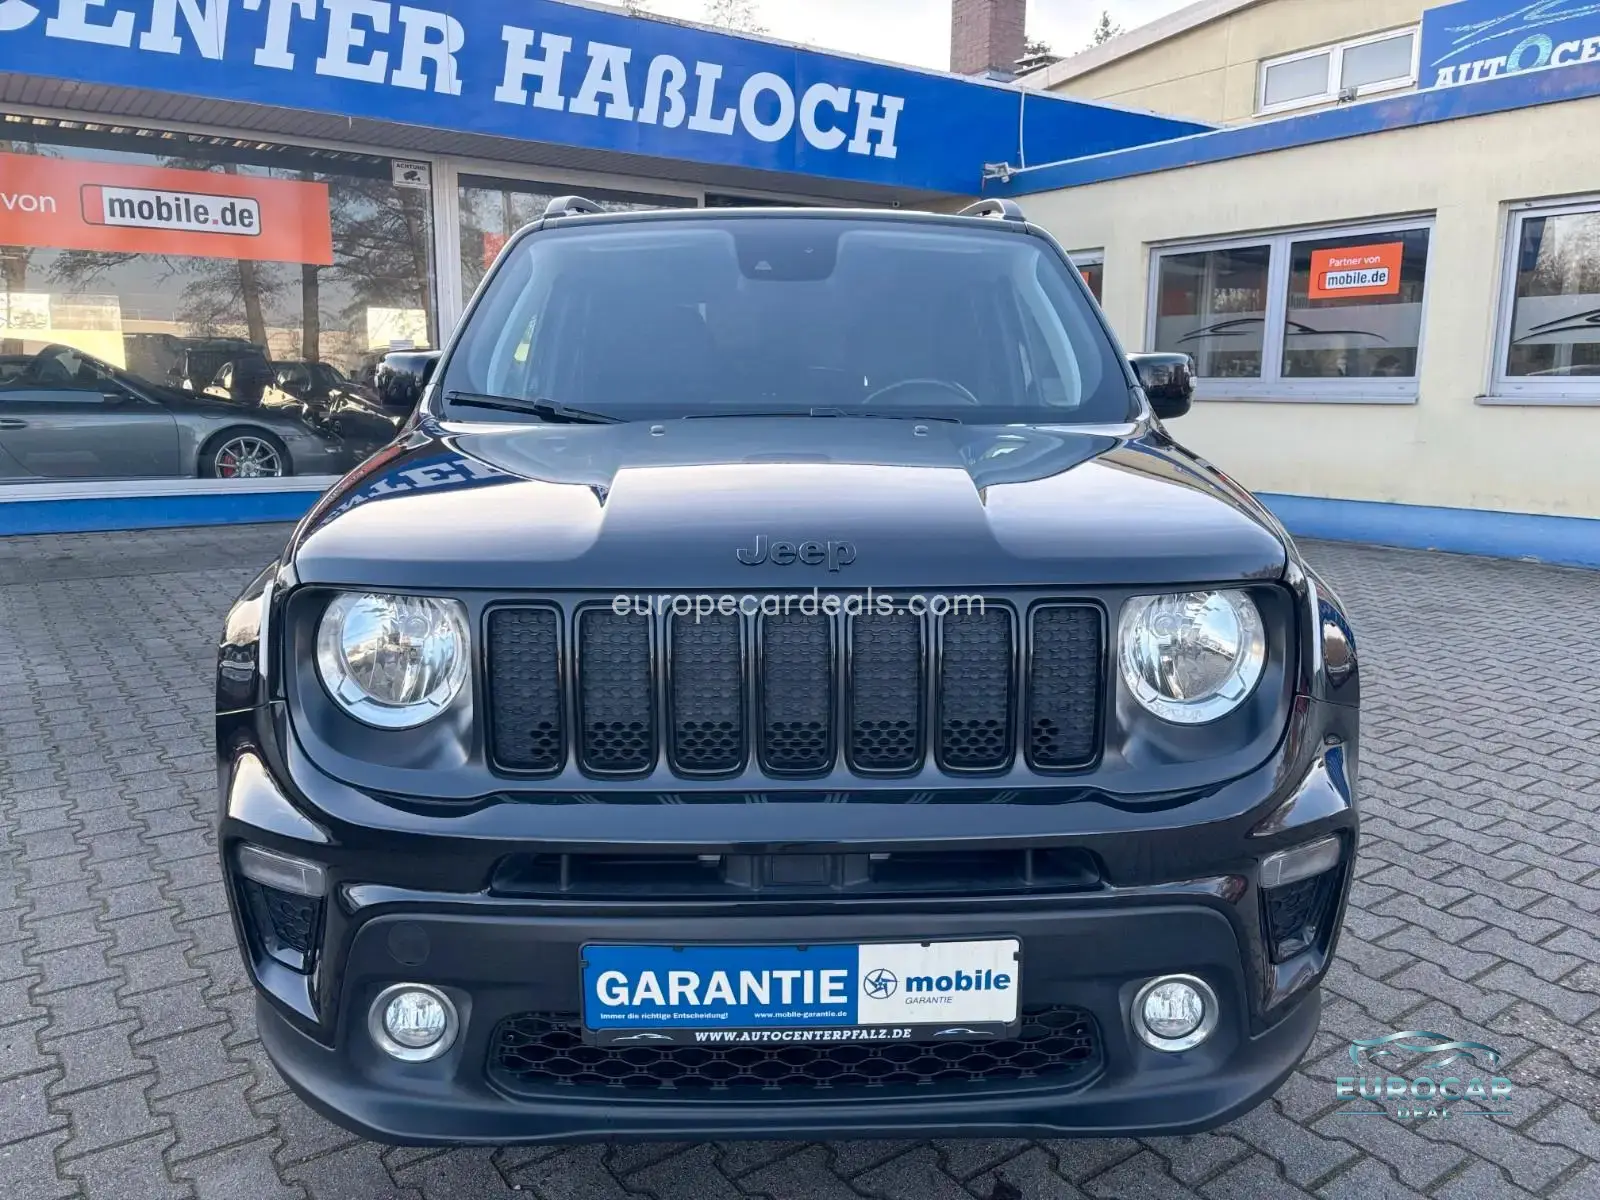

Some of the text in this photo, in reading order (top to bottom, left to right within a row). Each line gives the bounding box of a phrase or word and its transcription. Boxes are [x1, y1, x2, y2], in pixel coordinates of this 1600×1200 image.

[0, 0, 904, 159] ENTER HAßLOCH
[1, 192, 254, 228] von mobile.de
[1329, 256, 1381, 267] Partner von
[1328, 270, 1386, 287] mobile.de
[735, 534, 857, 573] Jeep
[596, 969, 1011, 1006] GARANTIE mobile
[905, 996, 954, 1005] GARANTIE
[641, 1012, 671, 1021] richtige
[673, 1012, 729, 1020] Entscheidung!
[754, 1010, 848, 1019] www.mobile-garantie.de
[694, 1028, 912, 1042] WWW.AUTOCENTERPFALZ.DE
